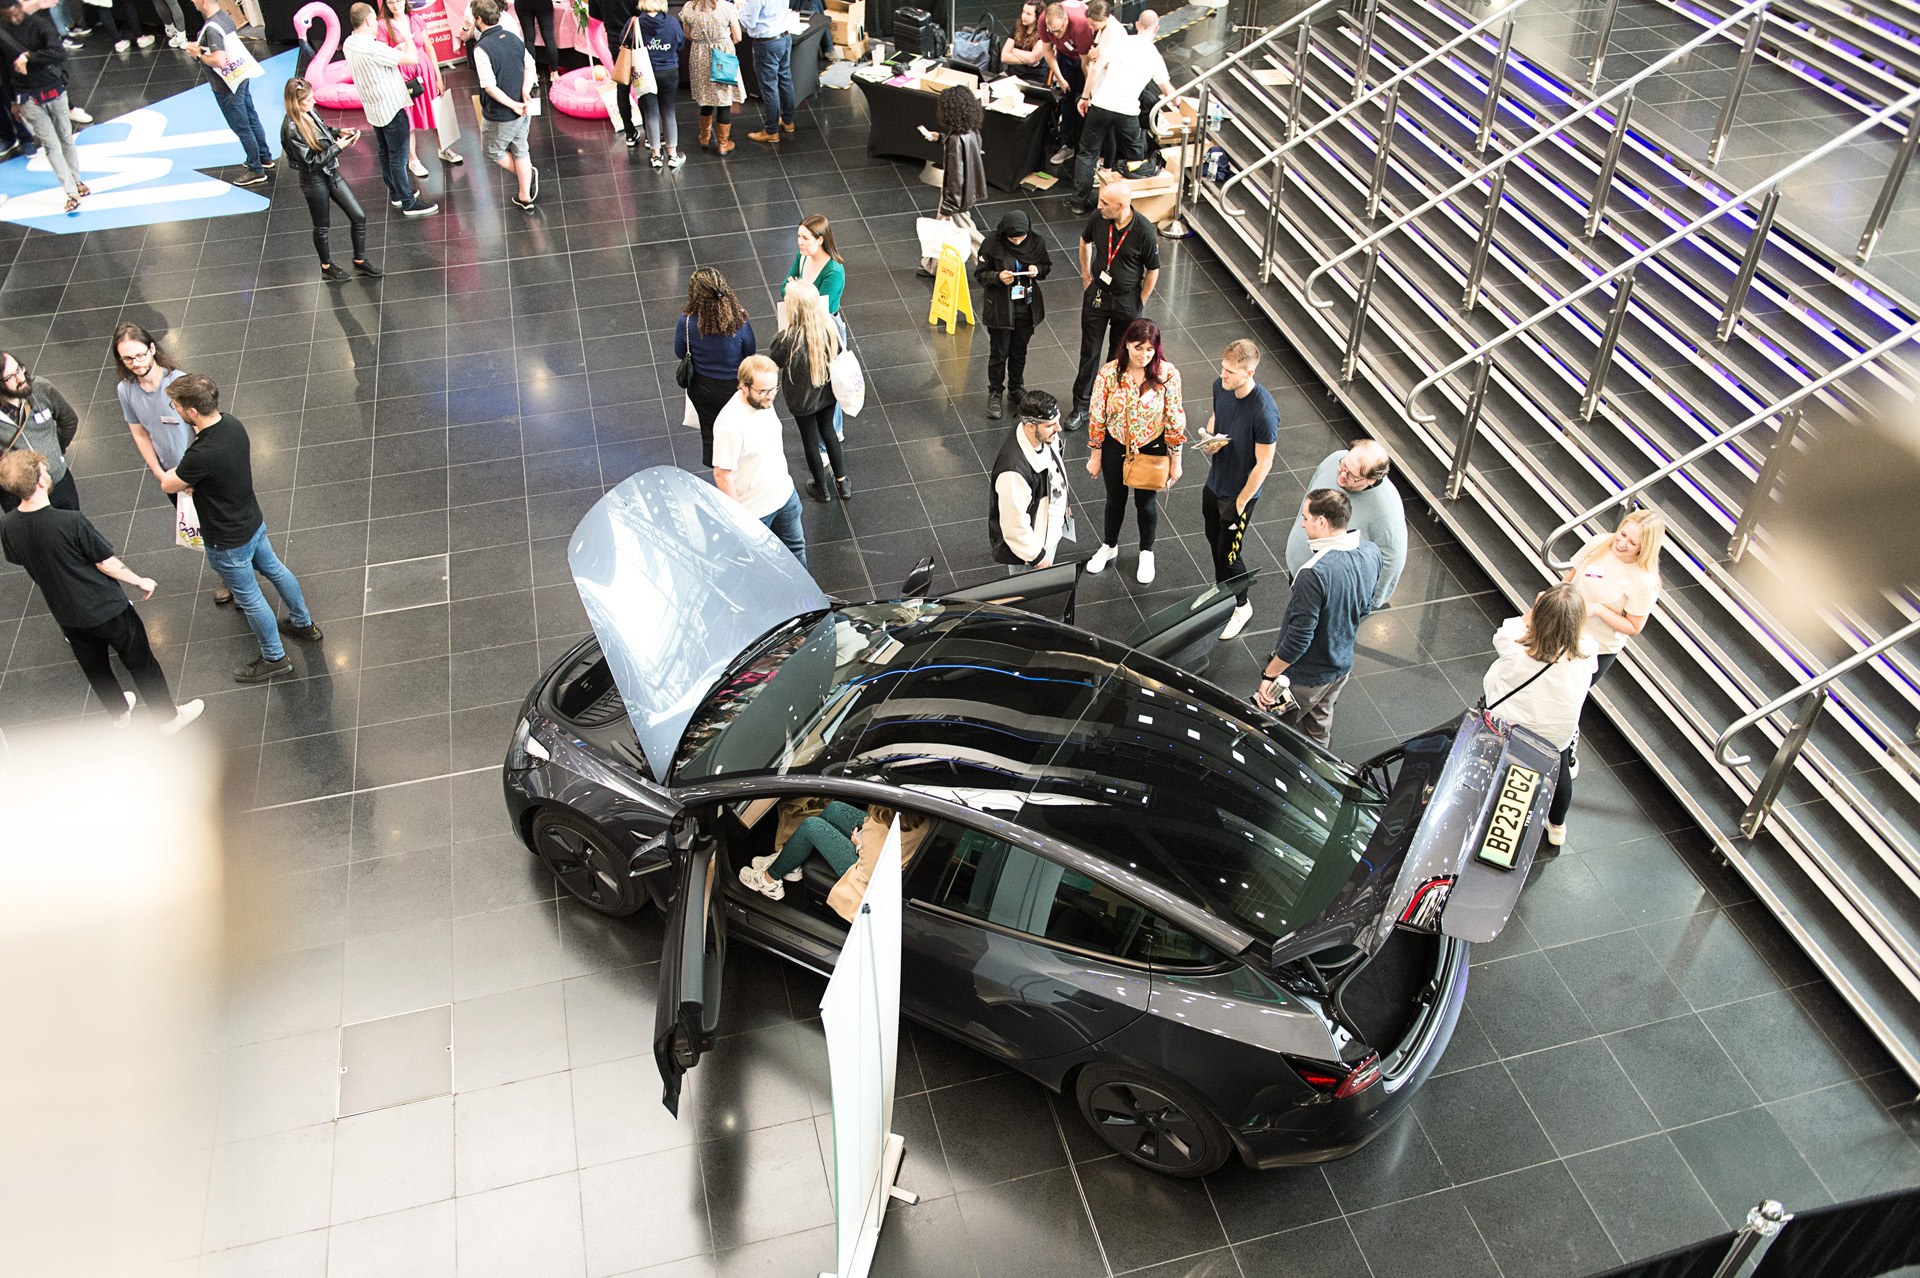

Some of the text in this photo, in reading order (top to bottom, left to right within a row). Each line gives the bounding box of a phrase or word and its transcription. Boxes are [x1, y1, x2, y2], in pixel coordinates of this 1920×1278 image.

[435, 34, 451, 43] 6620
[647, 43, 671, 51] vivup
[1486, 768, 1534, 854] BP23 PGZ
